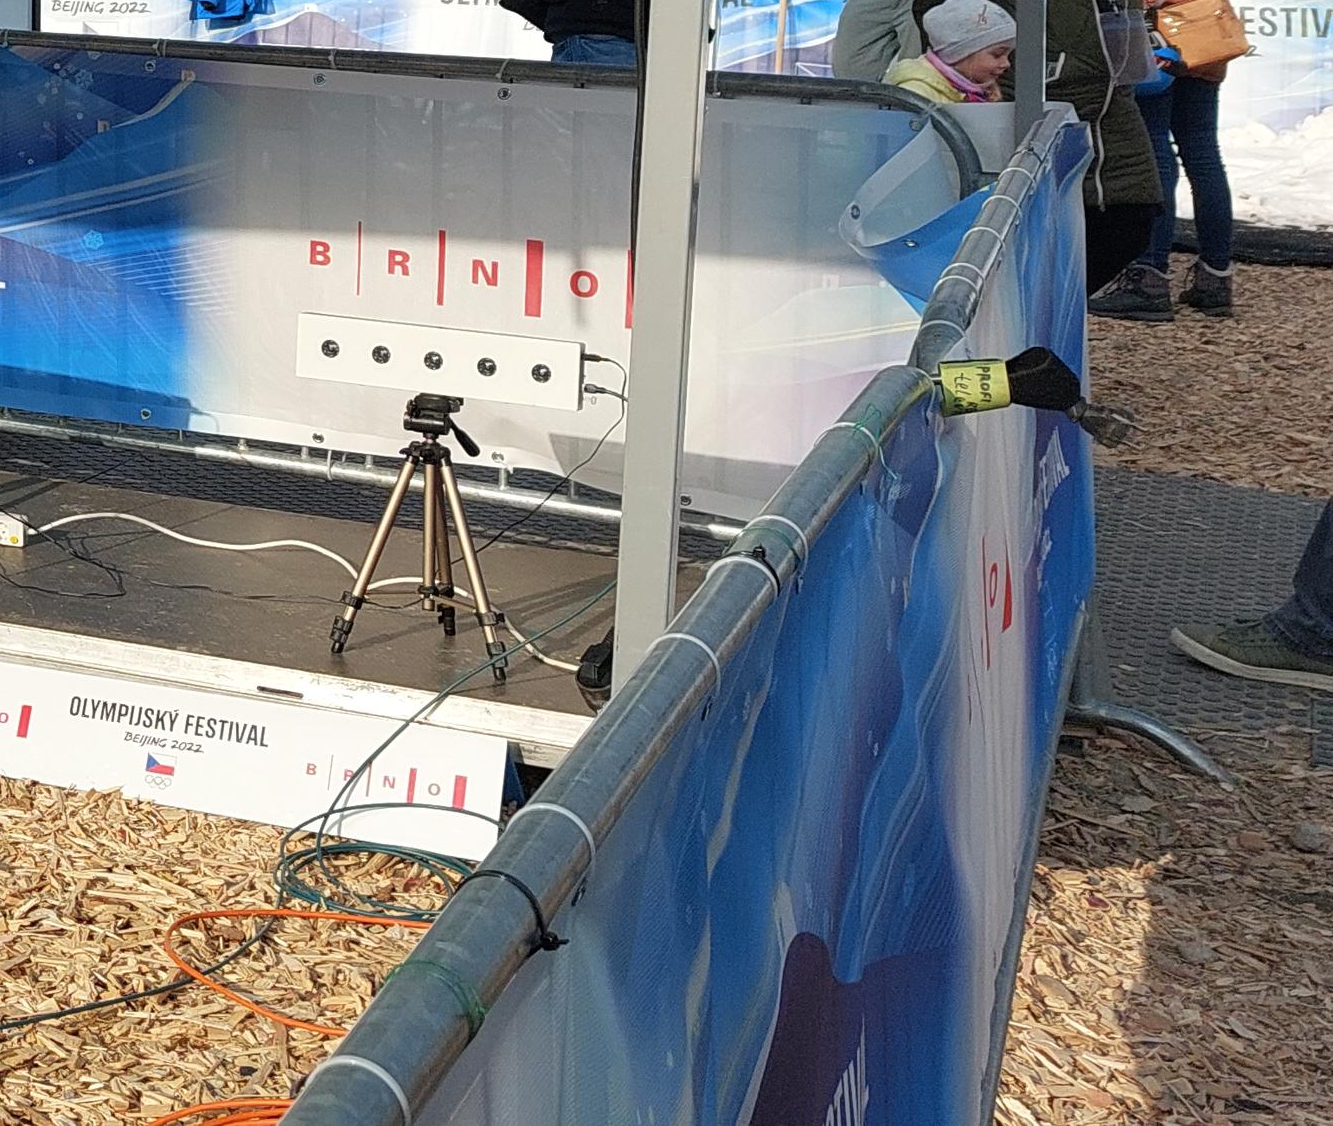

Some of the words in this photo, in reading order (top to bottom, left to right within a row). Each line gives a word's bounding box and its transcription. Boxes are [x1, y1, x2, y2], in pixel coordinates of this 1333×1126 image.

[51, 0, 105, 16] BEIJING
[108, 1, 151, 13] 2022
[69, 695, 181, 733] OLYMPIJSKÝ
[184, 714, 270, 748] FESTIVAL
[123, 730, 167, 750] BEIJING
[171, 740, 204, 754] 2022
